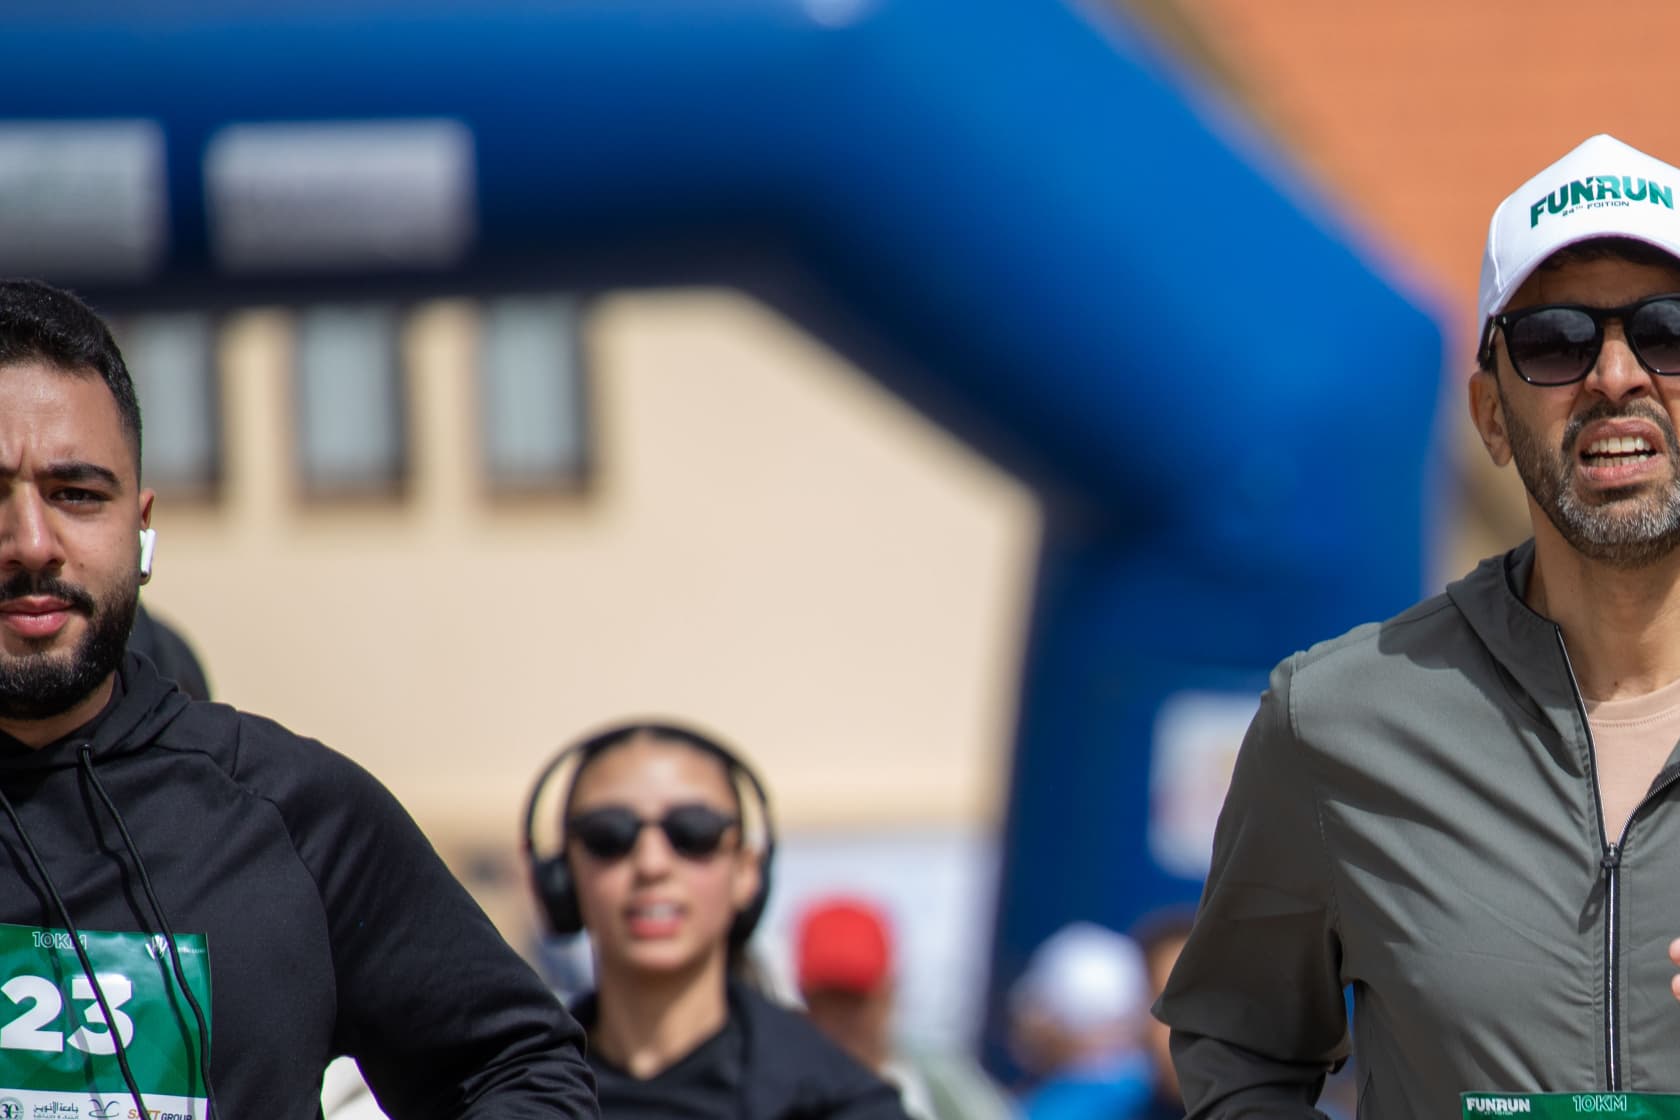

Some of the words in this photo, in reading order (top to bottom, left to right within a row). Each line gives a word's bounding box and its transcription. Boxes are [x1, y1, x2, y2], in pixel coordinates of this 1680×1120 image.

[1530, 175, 1674, 229] FUNRUN
[0, 974, 134, 1056] 23
[1466, 1097, 1531, 1113] FUNRUN
[1572, 1094, 1628, 1112] 10KM
[128, 1108, 161, 1120] STT
